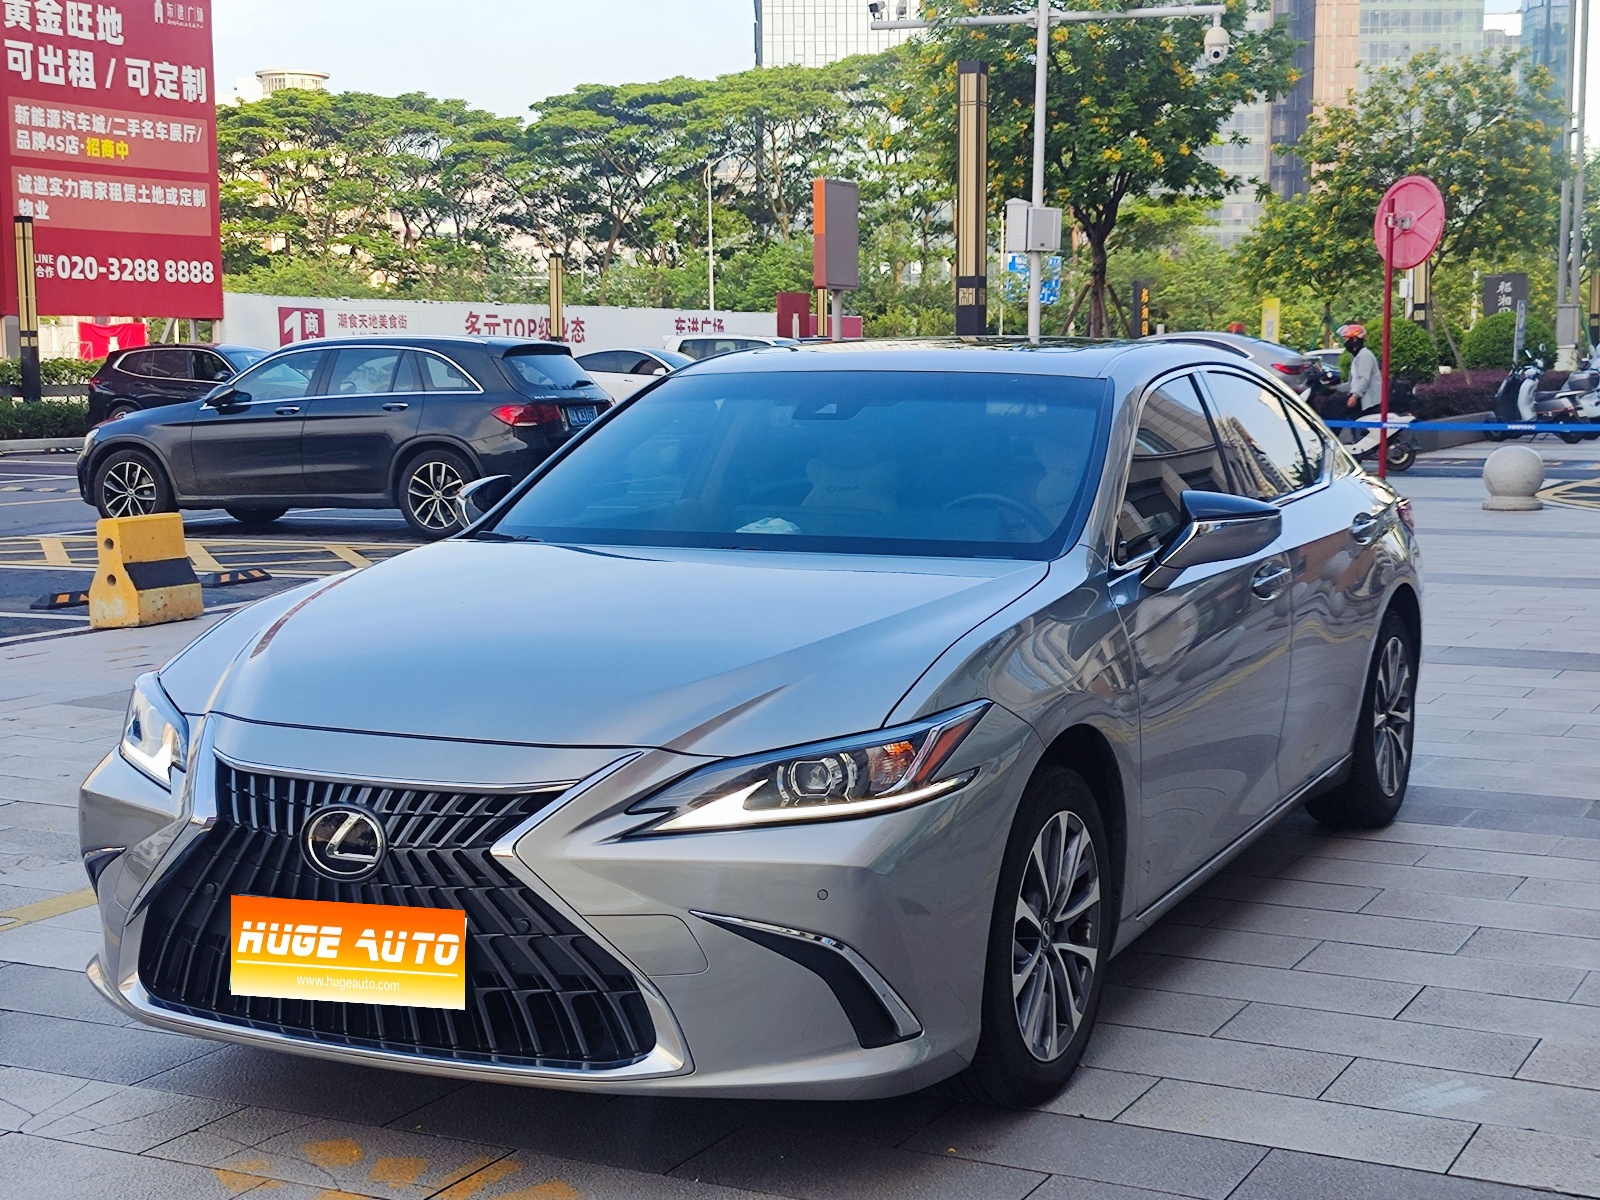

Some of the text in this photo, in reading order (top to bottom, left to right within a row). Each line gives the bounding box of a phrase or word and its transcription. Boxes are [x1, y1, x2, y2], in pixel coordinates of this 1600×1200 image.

[2, 0, 125, 46] 黄金旺地
[18, 174, 207, 208] 诚邀实力商家租赁土地或定制
[18, 199, 50, 220] 物业
[56, 254, 215, 284] 020-3288 8888
